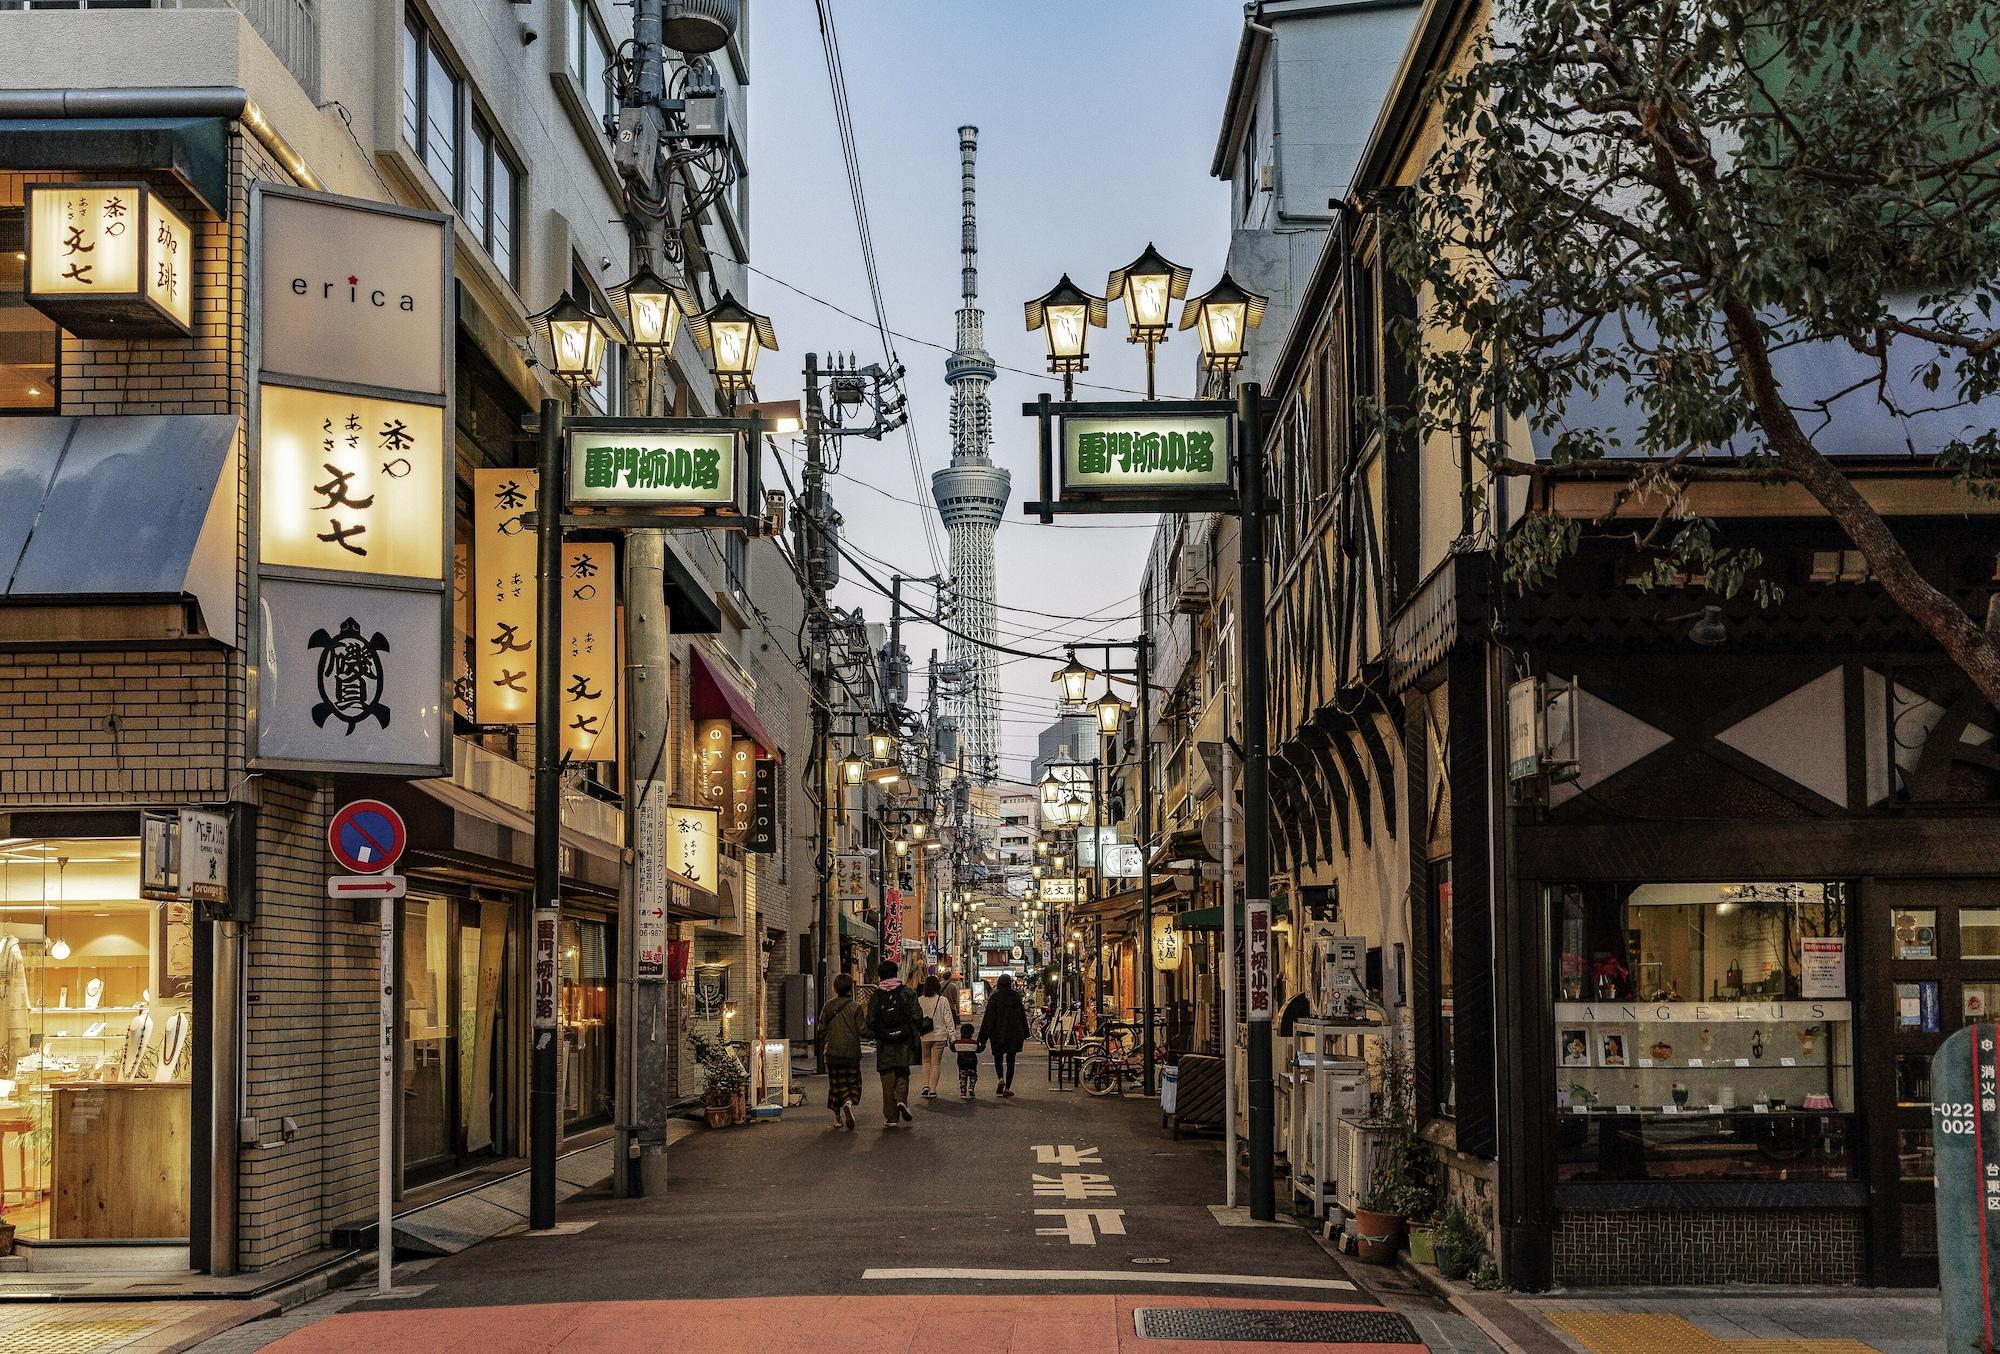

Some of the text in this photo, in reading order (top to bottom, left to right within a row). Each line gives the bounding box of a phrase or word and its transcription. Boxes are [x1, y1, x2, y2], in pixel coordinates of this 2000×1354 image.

[157, 219, 178, 302] 珈琲
[291, 276, 414, 312] erica
[309, 463, 375, 557] 文七
[735, 751, 749, 830] erica
[757, 769, 769, 842] erica
[1582, 1004, 1825, 1020] ANGELUS
[1981, 1064, 1997, 1112] 消火器
[1942, 1119, 1975, 1134] 002
